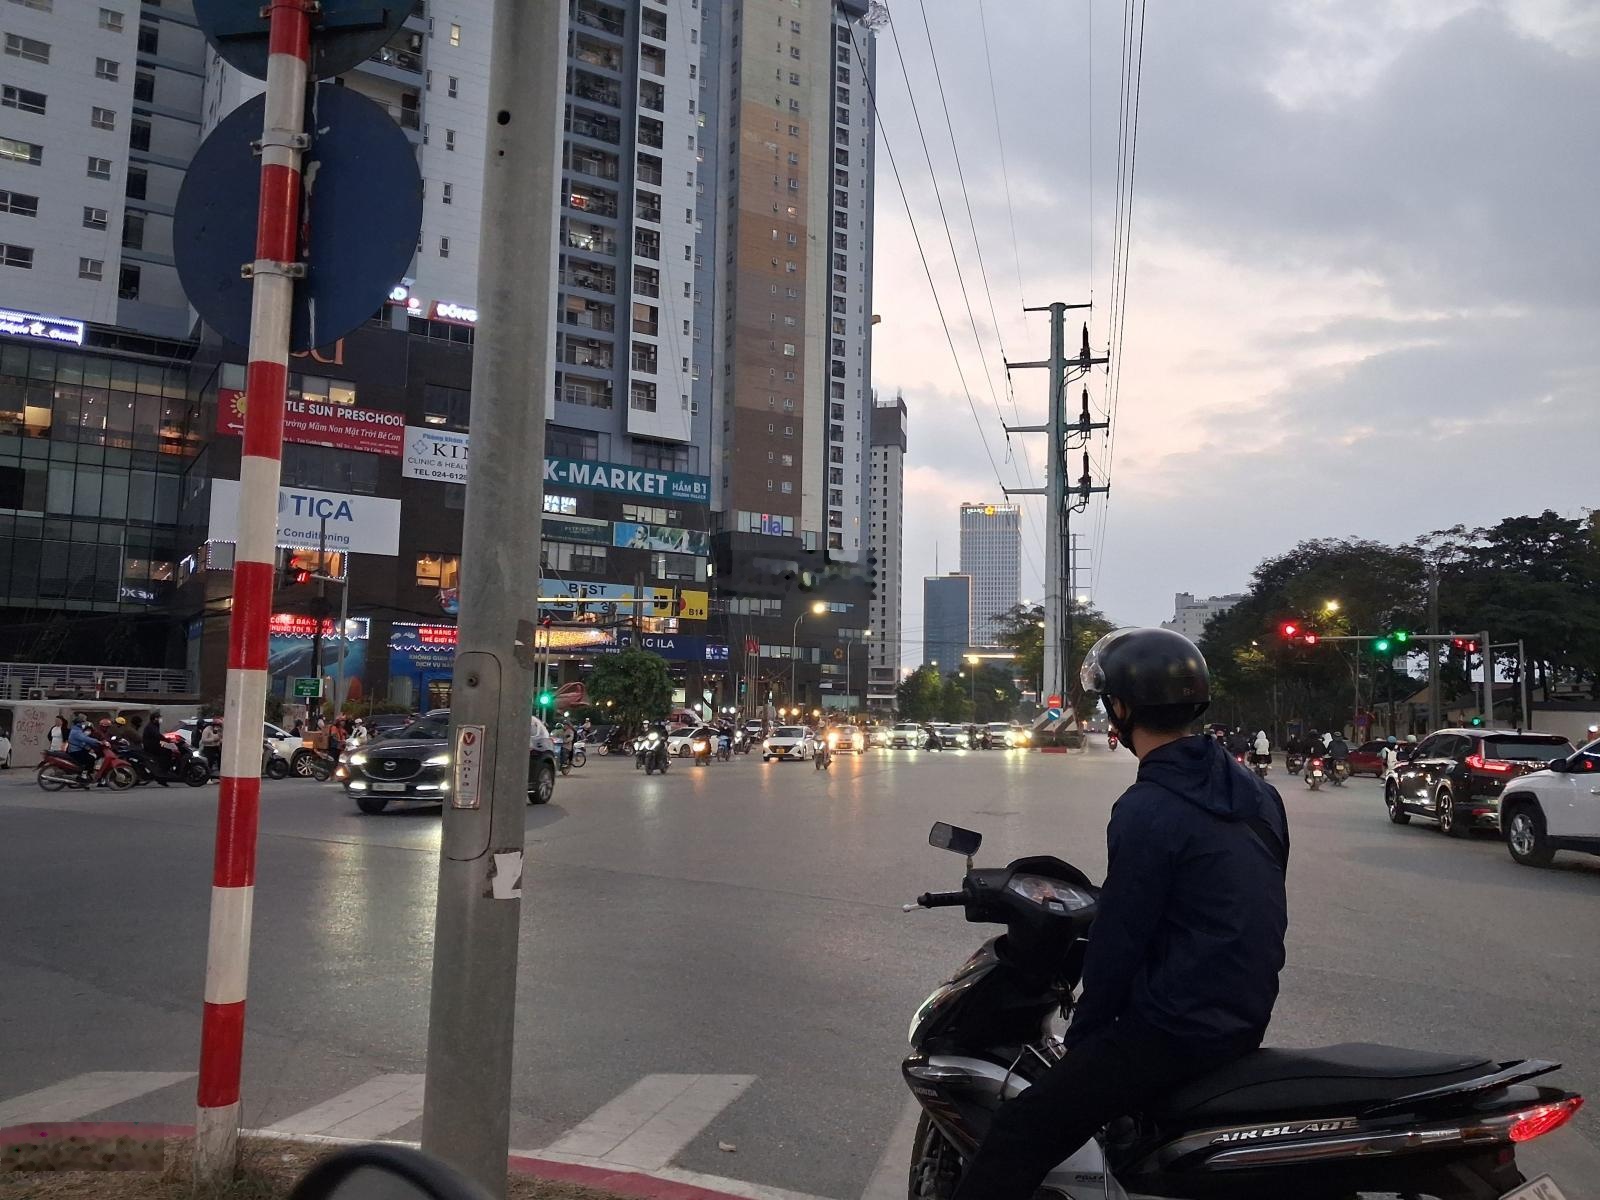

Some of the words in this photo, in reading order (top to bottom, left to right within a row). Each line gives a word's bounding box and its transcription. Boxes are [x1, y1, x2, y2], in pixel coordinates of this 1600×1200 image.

[309, 403, 333, 417] SUN
[337, 407, 404, 427] PRESCHOOL
[328, 424, 343, 434] Non
[387, 433, 401, 442] Con
[408, 456, 436, 466] CLINIC
[414, 468, 430, 476] TEL
[544, 459, 668, 495] K-MARKET
[693, 482, 707, 494] B1
[290, 494, 353, 522] TICA
[657, 639, 675, 649] ILA
